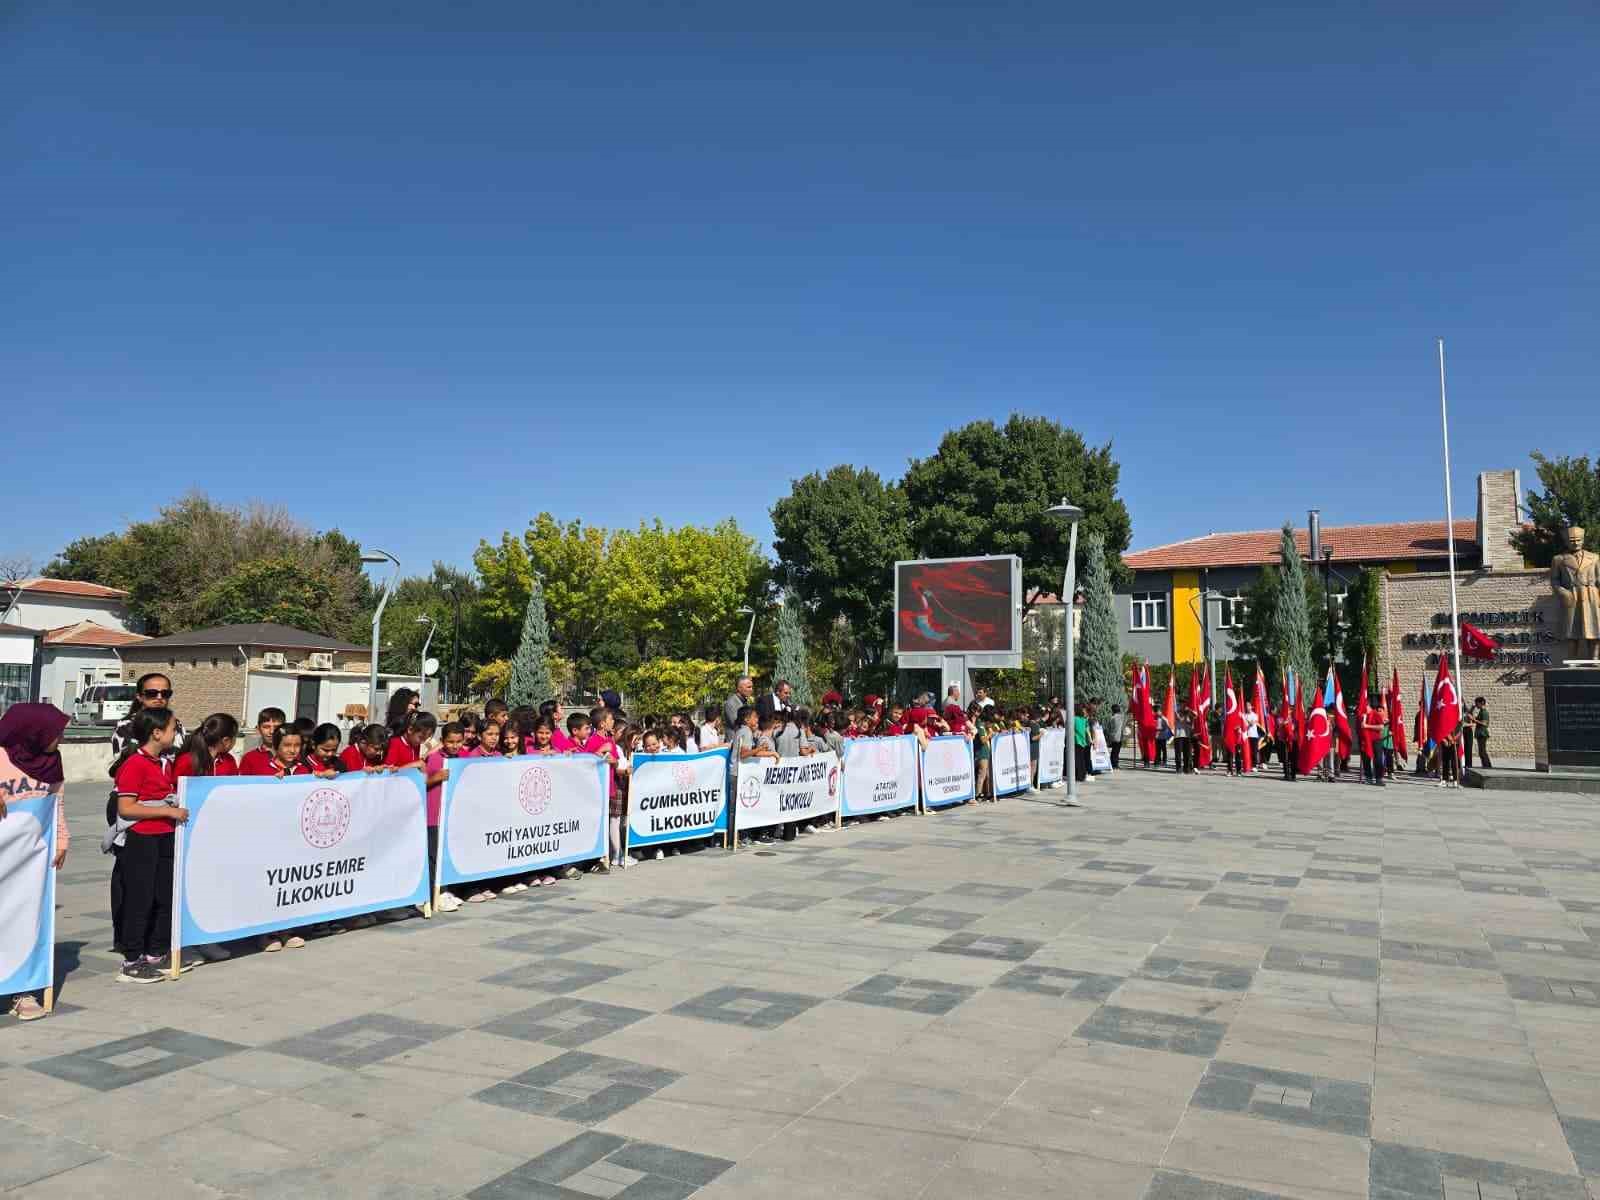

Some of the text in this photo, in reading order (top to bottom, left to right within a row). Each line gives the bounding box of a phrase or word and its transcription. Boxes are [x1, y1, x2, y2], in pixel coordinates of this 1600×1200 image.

[763, 767, 798, 784] MEHMET
[485, 819, 580, 846] TOKİ YAVUZ SELİM
[651, 810, 716, 832] İLKOKULU
[507, 839, 560, 860] İLKOKULU
[266, 856, 366, 886] YUNUS EMRE
[276, 879, 354, 908] İLKOKULU
